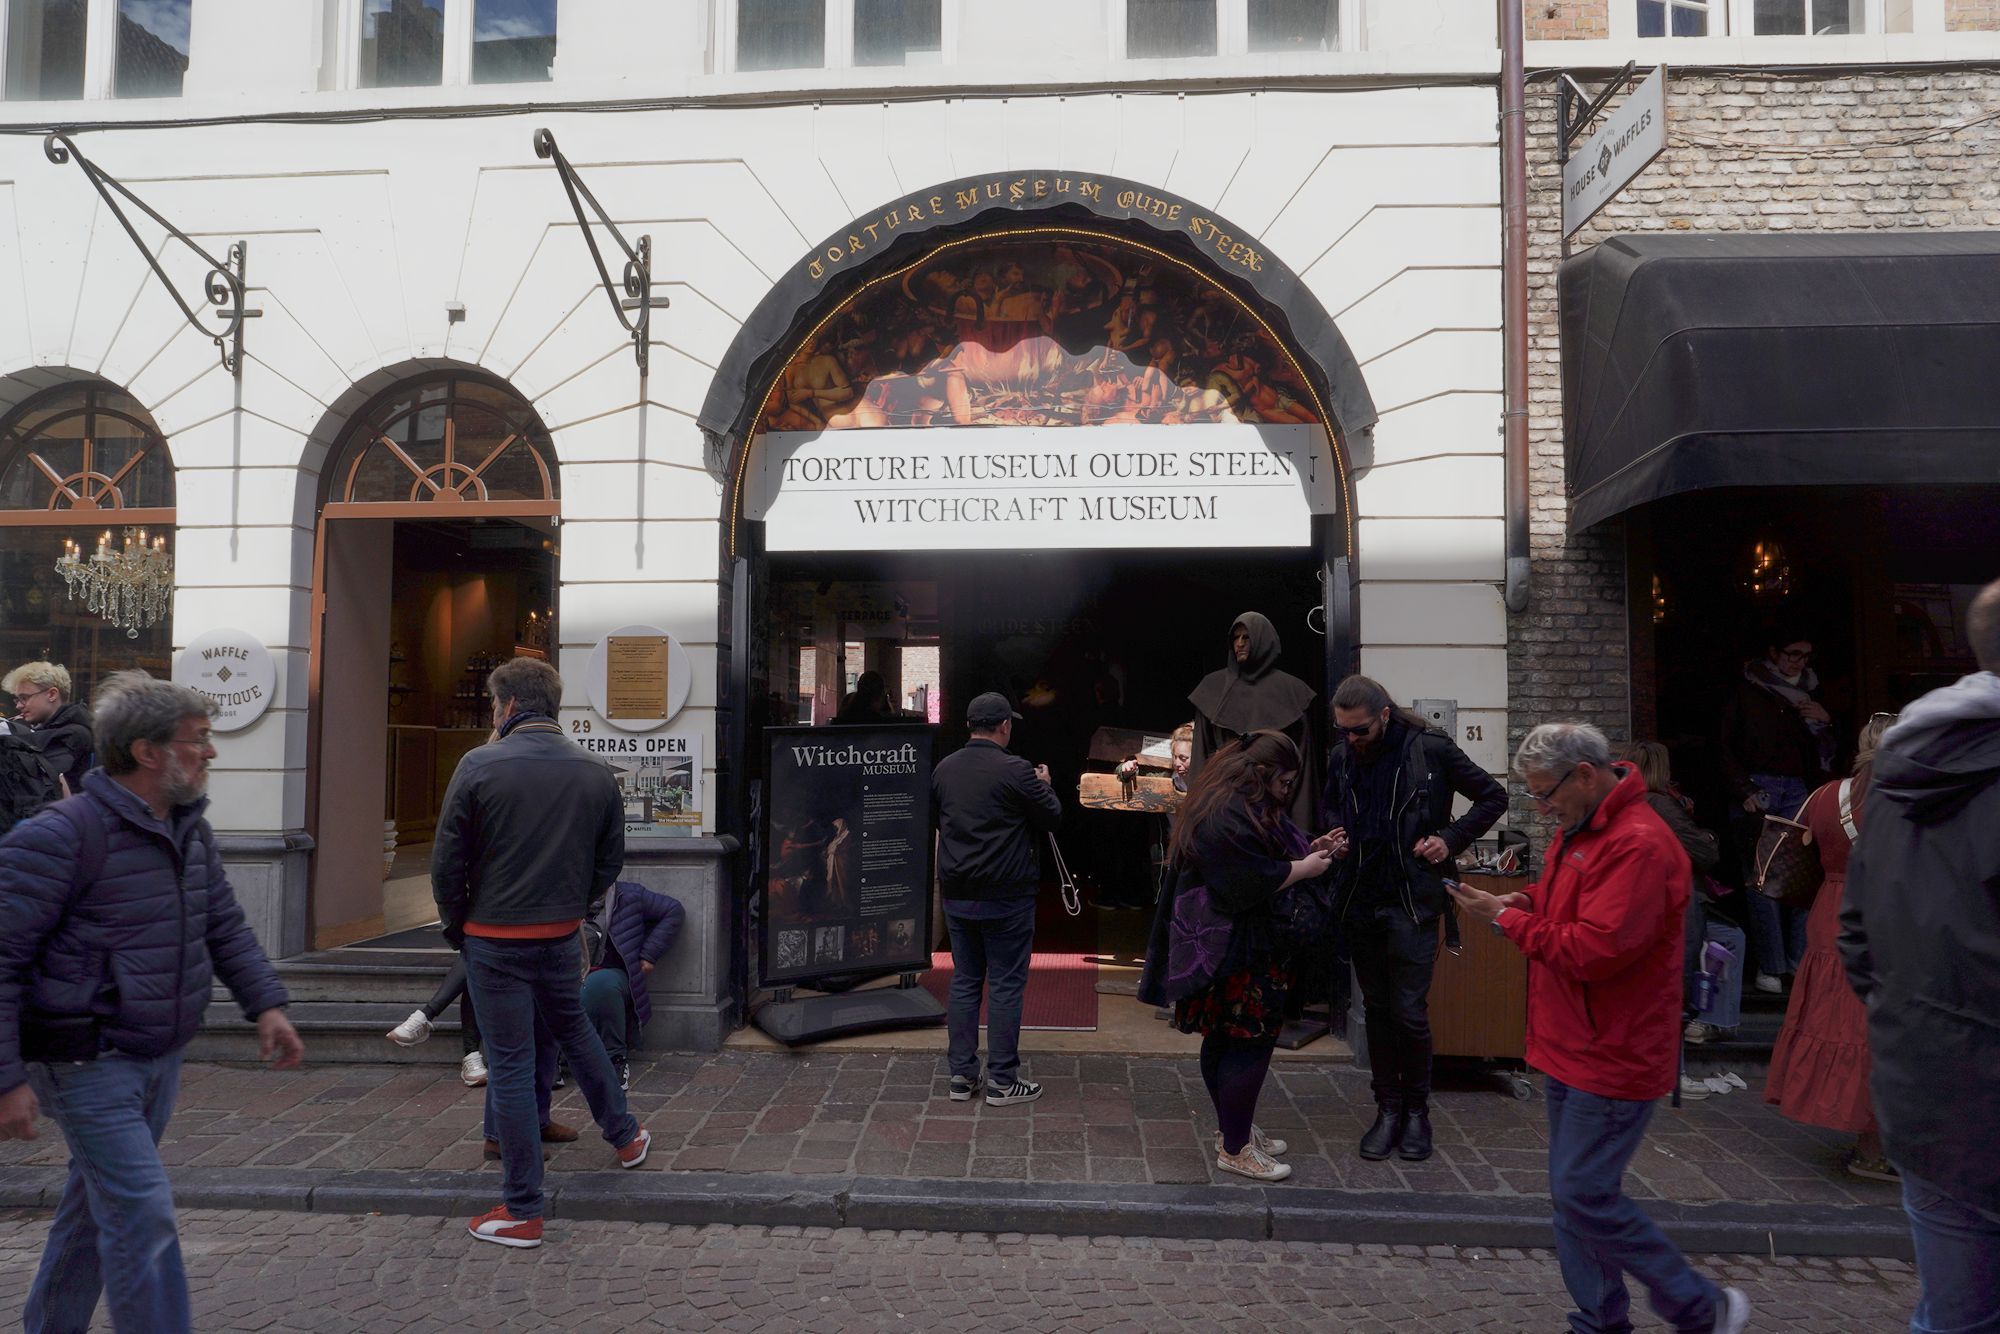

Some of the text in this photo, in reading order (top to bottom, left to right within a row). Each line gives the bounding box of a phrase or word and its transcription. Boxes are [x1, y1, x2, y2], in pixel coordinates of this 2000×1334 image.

[1570, 165, 1596, 201] HOUSE
[1613, 109, 1652, 158] WAFFLES
[808, 178, 1265, 279] TORTURE MUSEUM OUDE STEEN
[782, 456, 930, 481] TORTURE
[941, 453, 1078, 480] MUSEUM
[1089, 452, 1179, 478] OUDE
[1189, 451, 1293, 477] STEEN
[854, 495, 1219, 523] WITCHCRAFT MUSEUM
[202, 646, 249, 661] WAFFLE
[572, 719, 591, 733] 29
[1466, 725, 1483, 741] 31
[577, 738, 686, 752] TERRAS OPEN
[792, 743, 918, 768] Witchcraft
[862, 763, 917, 776] MUSEUM
